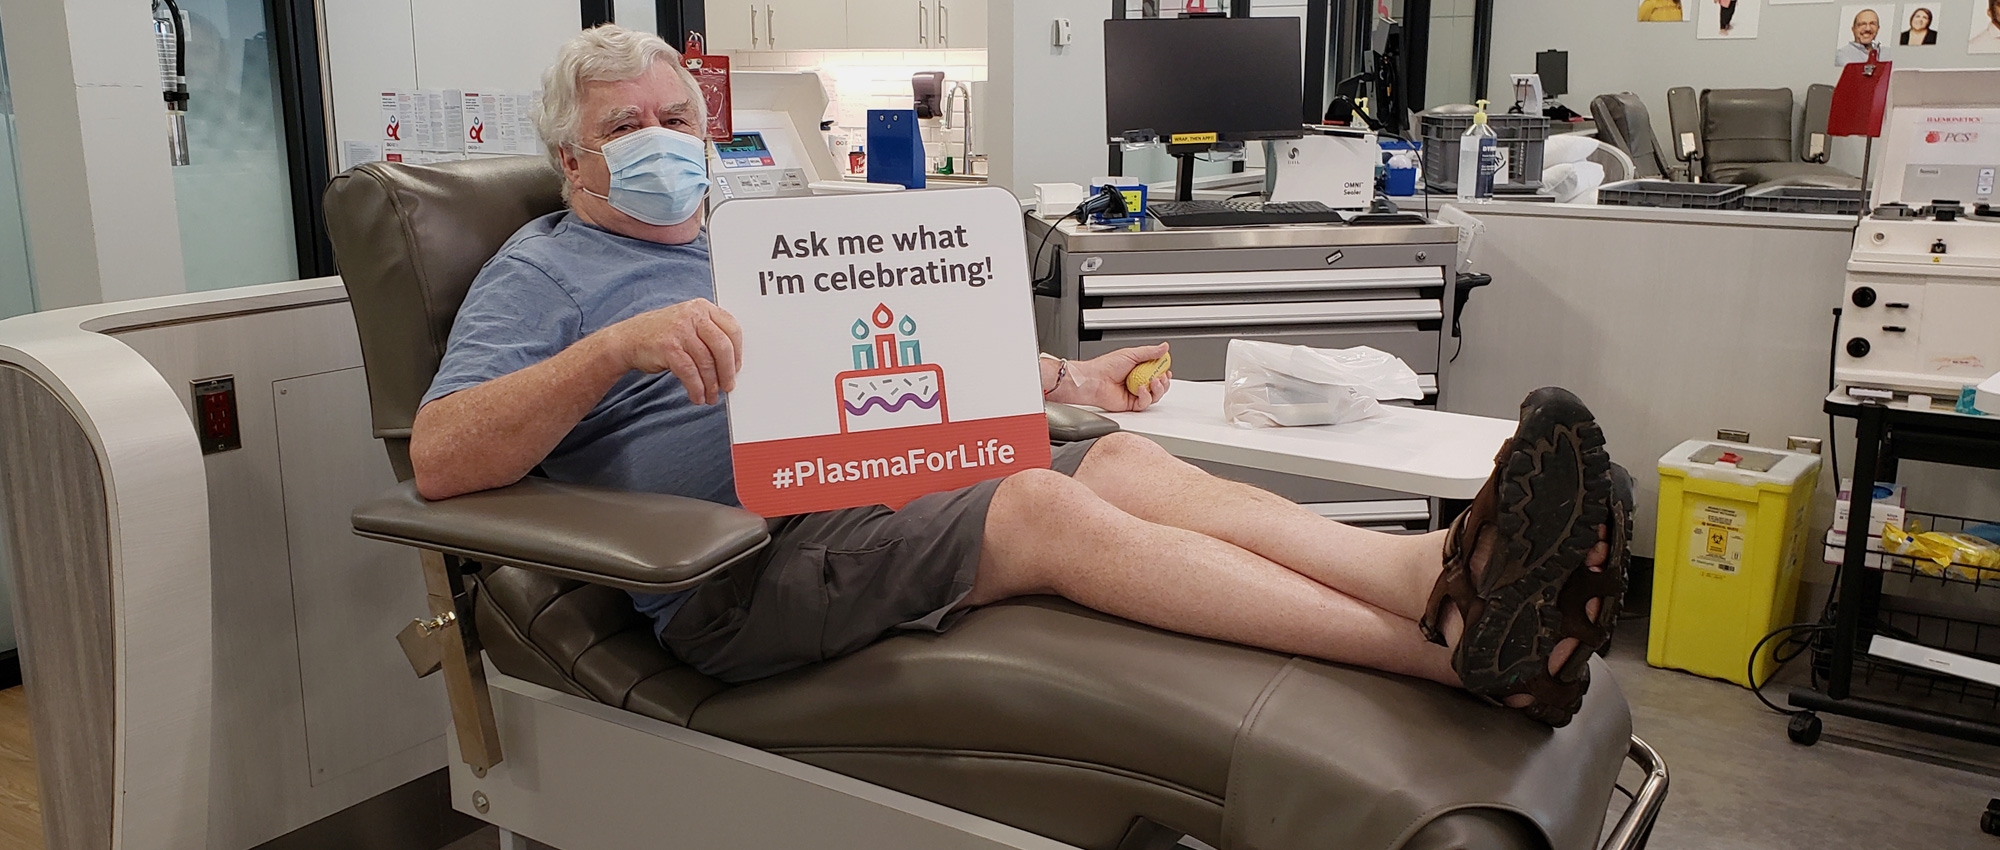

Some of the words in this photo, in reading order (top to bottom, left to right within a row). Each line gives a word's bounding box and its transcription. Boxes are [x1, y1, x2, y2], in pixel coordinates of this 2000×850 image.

[771, 231, 829, 259] Ask
[837, 234, 884, 255] me
[891, 225, 969, 251] what
[758, 270, 805, 296] I'm
[813, 257, 994, 292] celebrating!
[772, 439, 1015, 489] #PlasmaForLife
